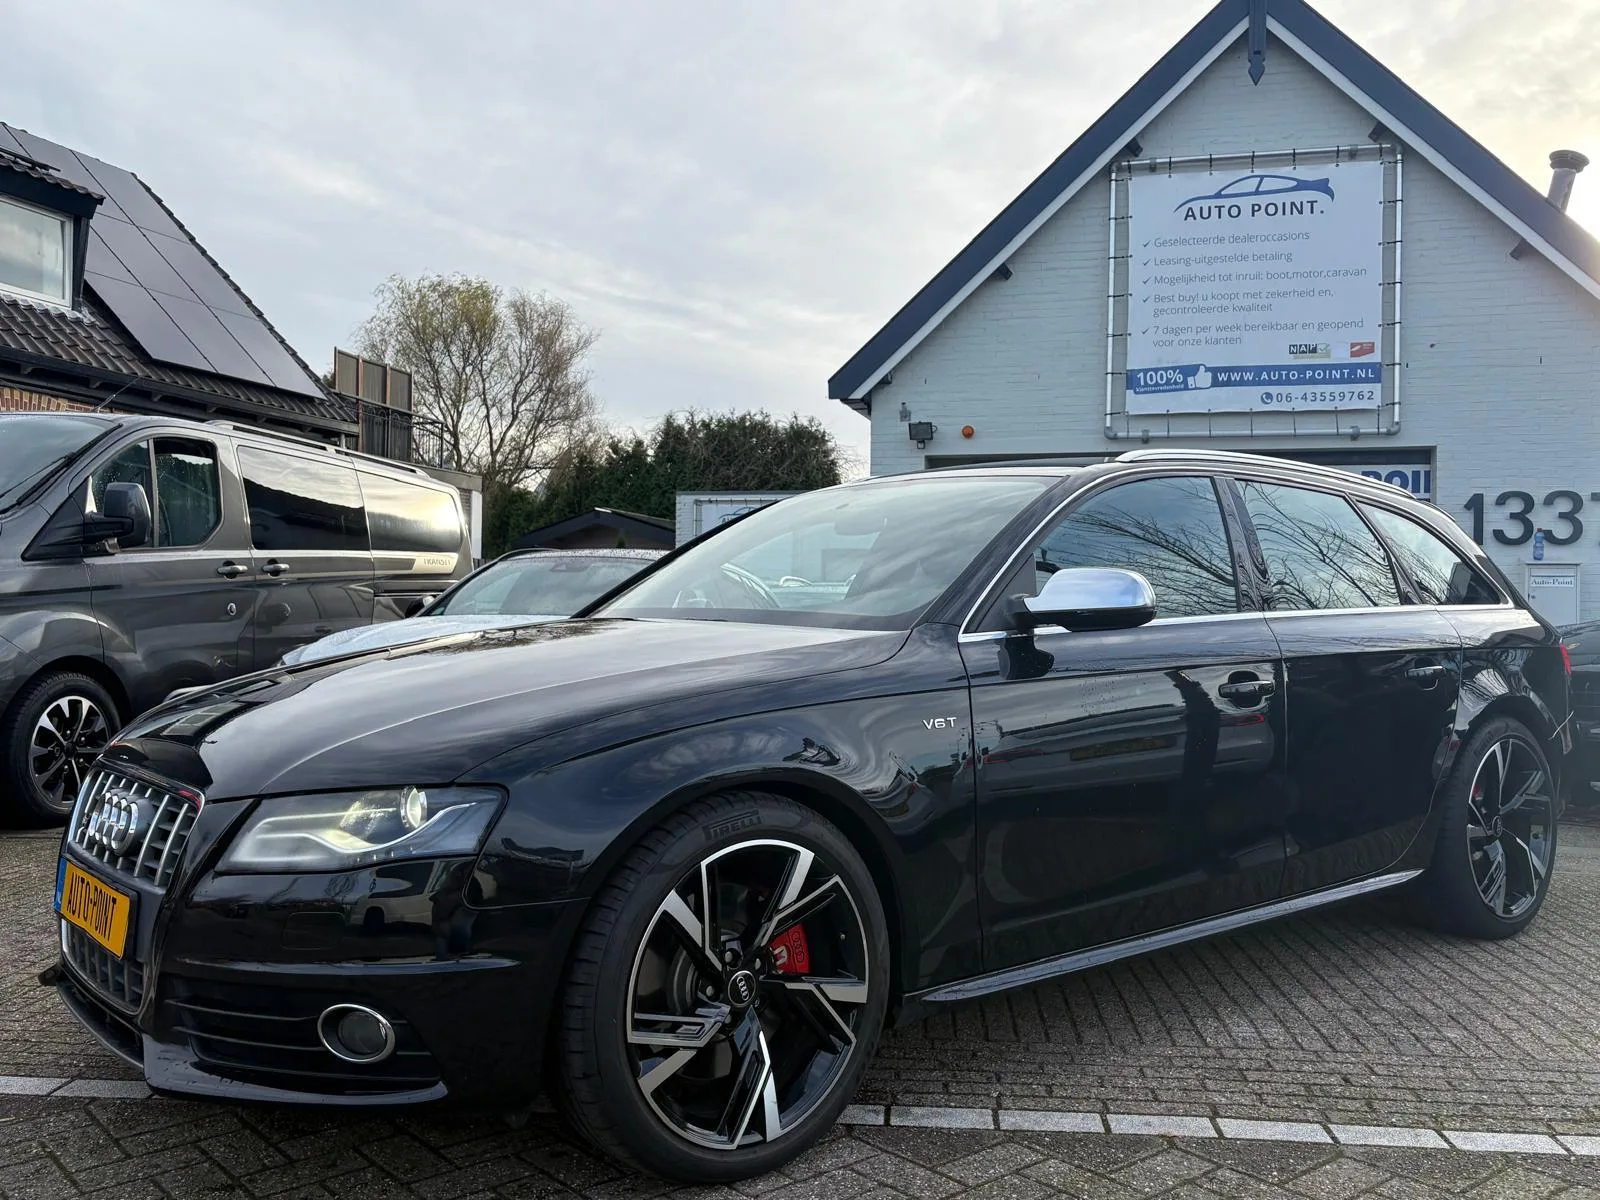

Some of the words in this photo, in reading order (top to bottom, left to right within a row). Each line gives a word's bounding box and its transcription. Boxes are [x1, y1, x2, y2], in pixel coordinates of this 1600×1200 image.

[1184, 204, 1242, 221] AUTO
[1251, 200, 1325, 218] POINT.
[1154, 235, 1226, 248] Geselecteerde
[1228, 231, 1310, 244] dealeroccasions
[1154, 253, 1249, 267] Leasing-uitgestelde
[1252, 251, 1293, 263] betaling
[1154, 273, 1216, 287] Mogelijkheid
[1218, 272, 1233, 282] tot
[1154, 294, 1175, 303] Best
[1178, 292, 1199, 304] buy!
[1201, 293, 1208, 301] u
[1211, 291, 1240, 301] koopt
[1243, 290, 1262, 300] met
[1265, 287, 1315, 299] zekerheid
[1153, 303, 1230, 318] gecontroleerde
[1232, 302, 1273, 313] kwaliteit
[1153, 325, 1160, 335] 7
[1162, 325, 1193, 337] dagen
[1195, 325, 1212, 335] per
[1215, 323, 1242, 333] week
[1244, 320, 1298, 332] bereikbaar
[1301, 320, 1315, 330] en
[1317, 318, 1364, 332] geopend
[1153, 339, 1174, 348] voor
[1177, 337, 1202, 346] onze
[1204, 335, 1242, 346] klanten
[1289, 343, 1318, 355] NAP
[1137, 369, 1184, 386] 100%
[1217, 368, 1375, 381] WWW.AUTO-POINT.NL
[1275, 390, 1375, 403] 06-43559762
[1463, 490, 1600, 545] 133
[1531, 578, 1574, 586] Auto-Point
[922, 716, 957, 729] V6T
[66, 872, 117, 942] AUTO-POINT
